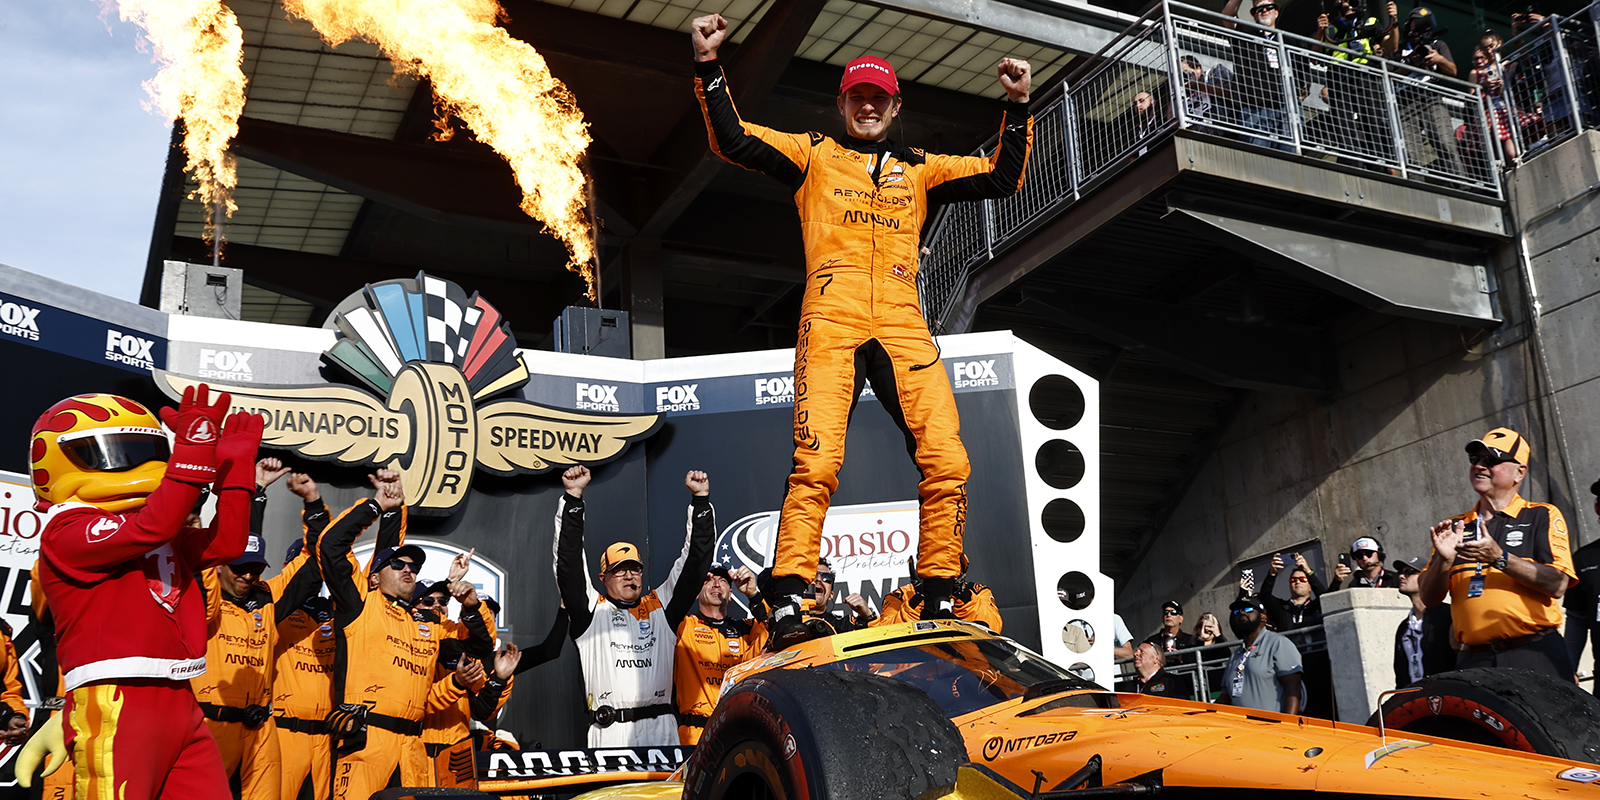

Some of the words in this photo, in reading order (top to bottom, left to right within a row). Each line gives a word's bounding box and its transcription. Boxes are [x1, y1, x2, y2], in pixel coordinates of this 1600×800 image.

[833, 188, 908, 207] REYNOLDS
[843, 210, 900, 230] ARROW
[816, 273, 833, 295] 7
[0, 299, 41, 331] OX
[0, 323, 40, 341] ORTS
[106, 329, 155, 362] FOX
[105, 351, 154, 371] SPORTS
[199, 349, 253, 373] FOX
[952, 359, 998, 382] FOX
[198, 369, 253, 381] SPORTS
[954, 377, 999, 388] SPORTS
[576, 382, 619, 405] FOX
[656, 384, 699, 406] FOX
[754, 376, 795, 397] FOX
[576, 402, 620, 412] SPORTS
[656, 402, 700, 413] SPORTS
[437, 381, 469, 494] MOTOR
[490, 426, 603, 453] SPEEDWAY
[826, 576, 912, 617] AN
[1004, 736, 1036, 753] NTT
